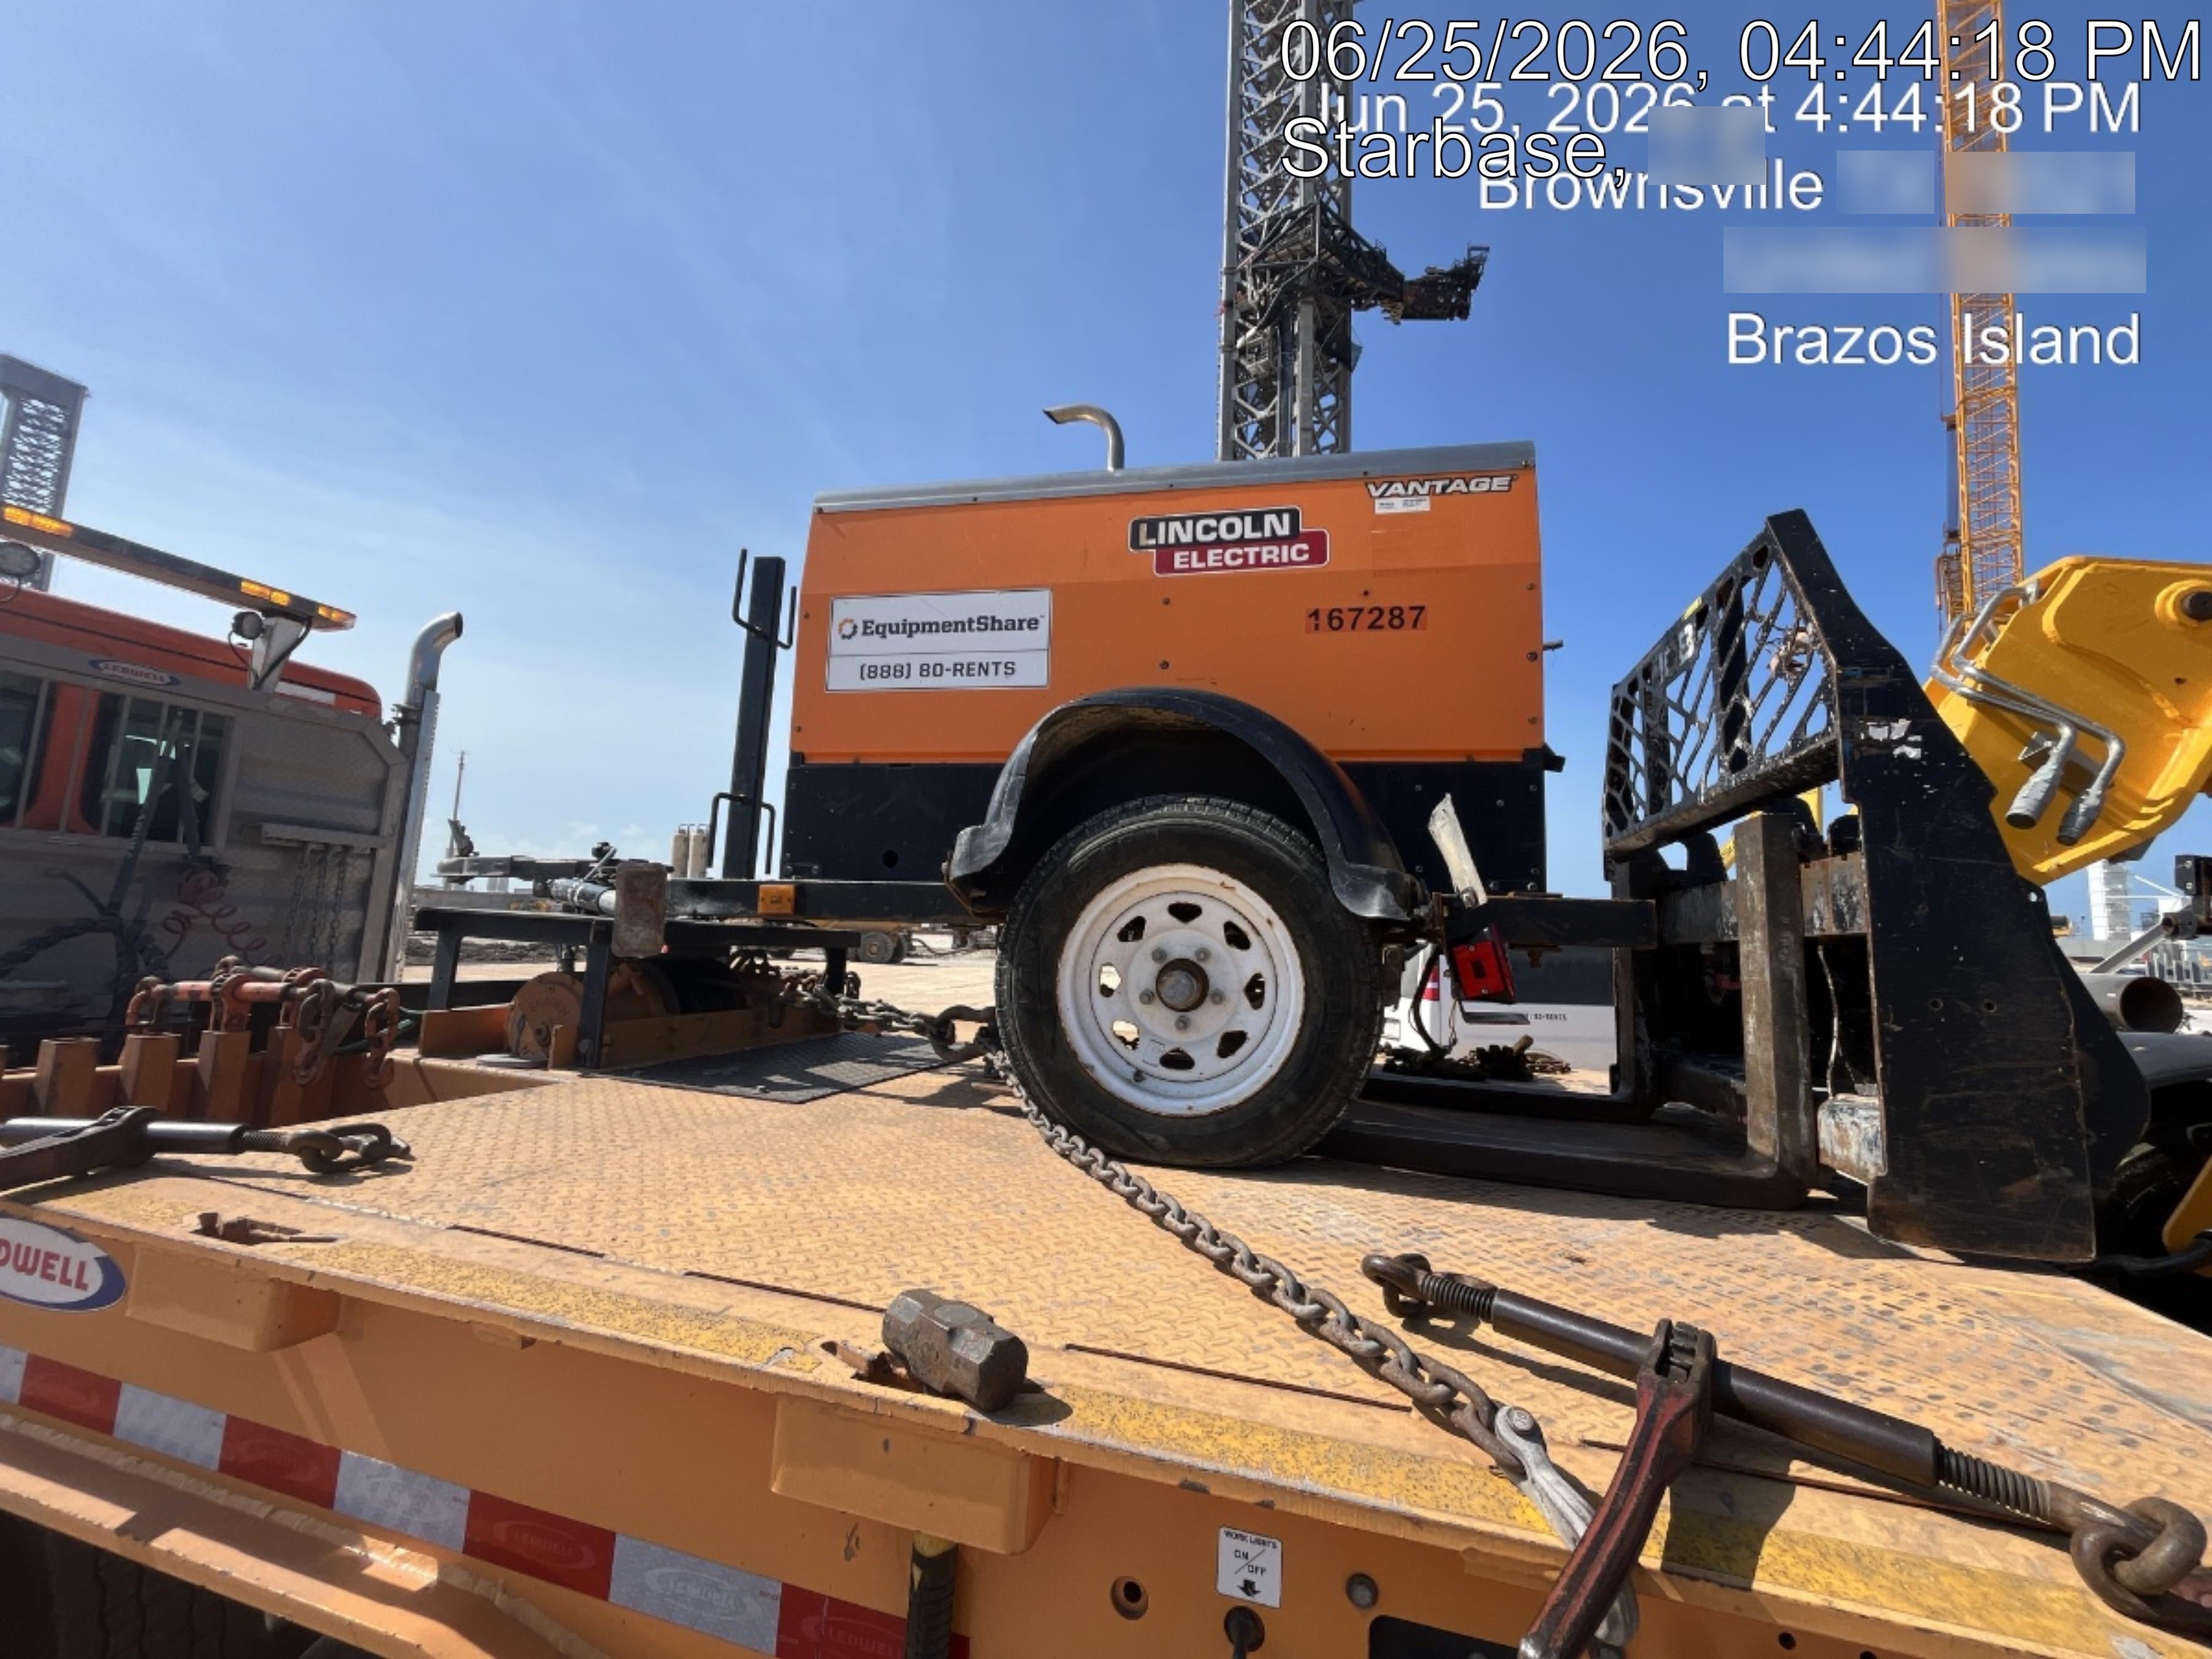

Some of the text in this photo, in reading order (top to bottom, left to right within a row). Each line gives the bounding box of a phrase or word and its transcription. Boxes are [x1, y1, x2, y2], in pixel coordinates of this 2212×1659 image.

[1367, 476, 1513, 497] VANTAGE
[1138, 512, 1290, 546] LINCOLN
[1173, 543, 1310, 570] ELECTRIC
[861, 615, 1040, 638] EquipmentShare
[1308, 606, 1426, 631] 167287
[860, 661, 1016, 680] (888) 80-RENTS
[1234, 1549, 1249, 1560] ON
[1248, 1564, 1266, 1576] OFF
